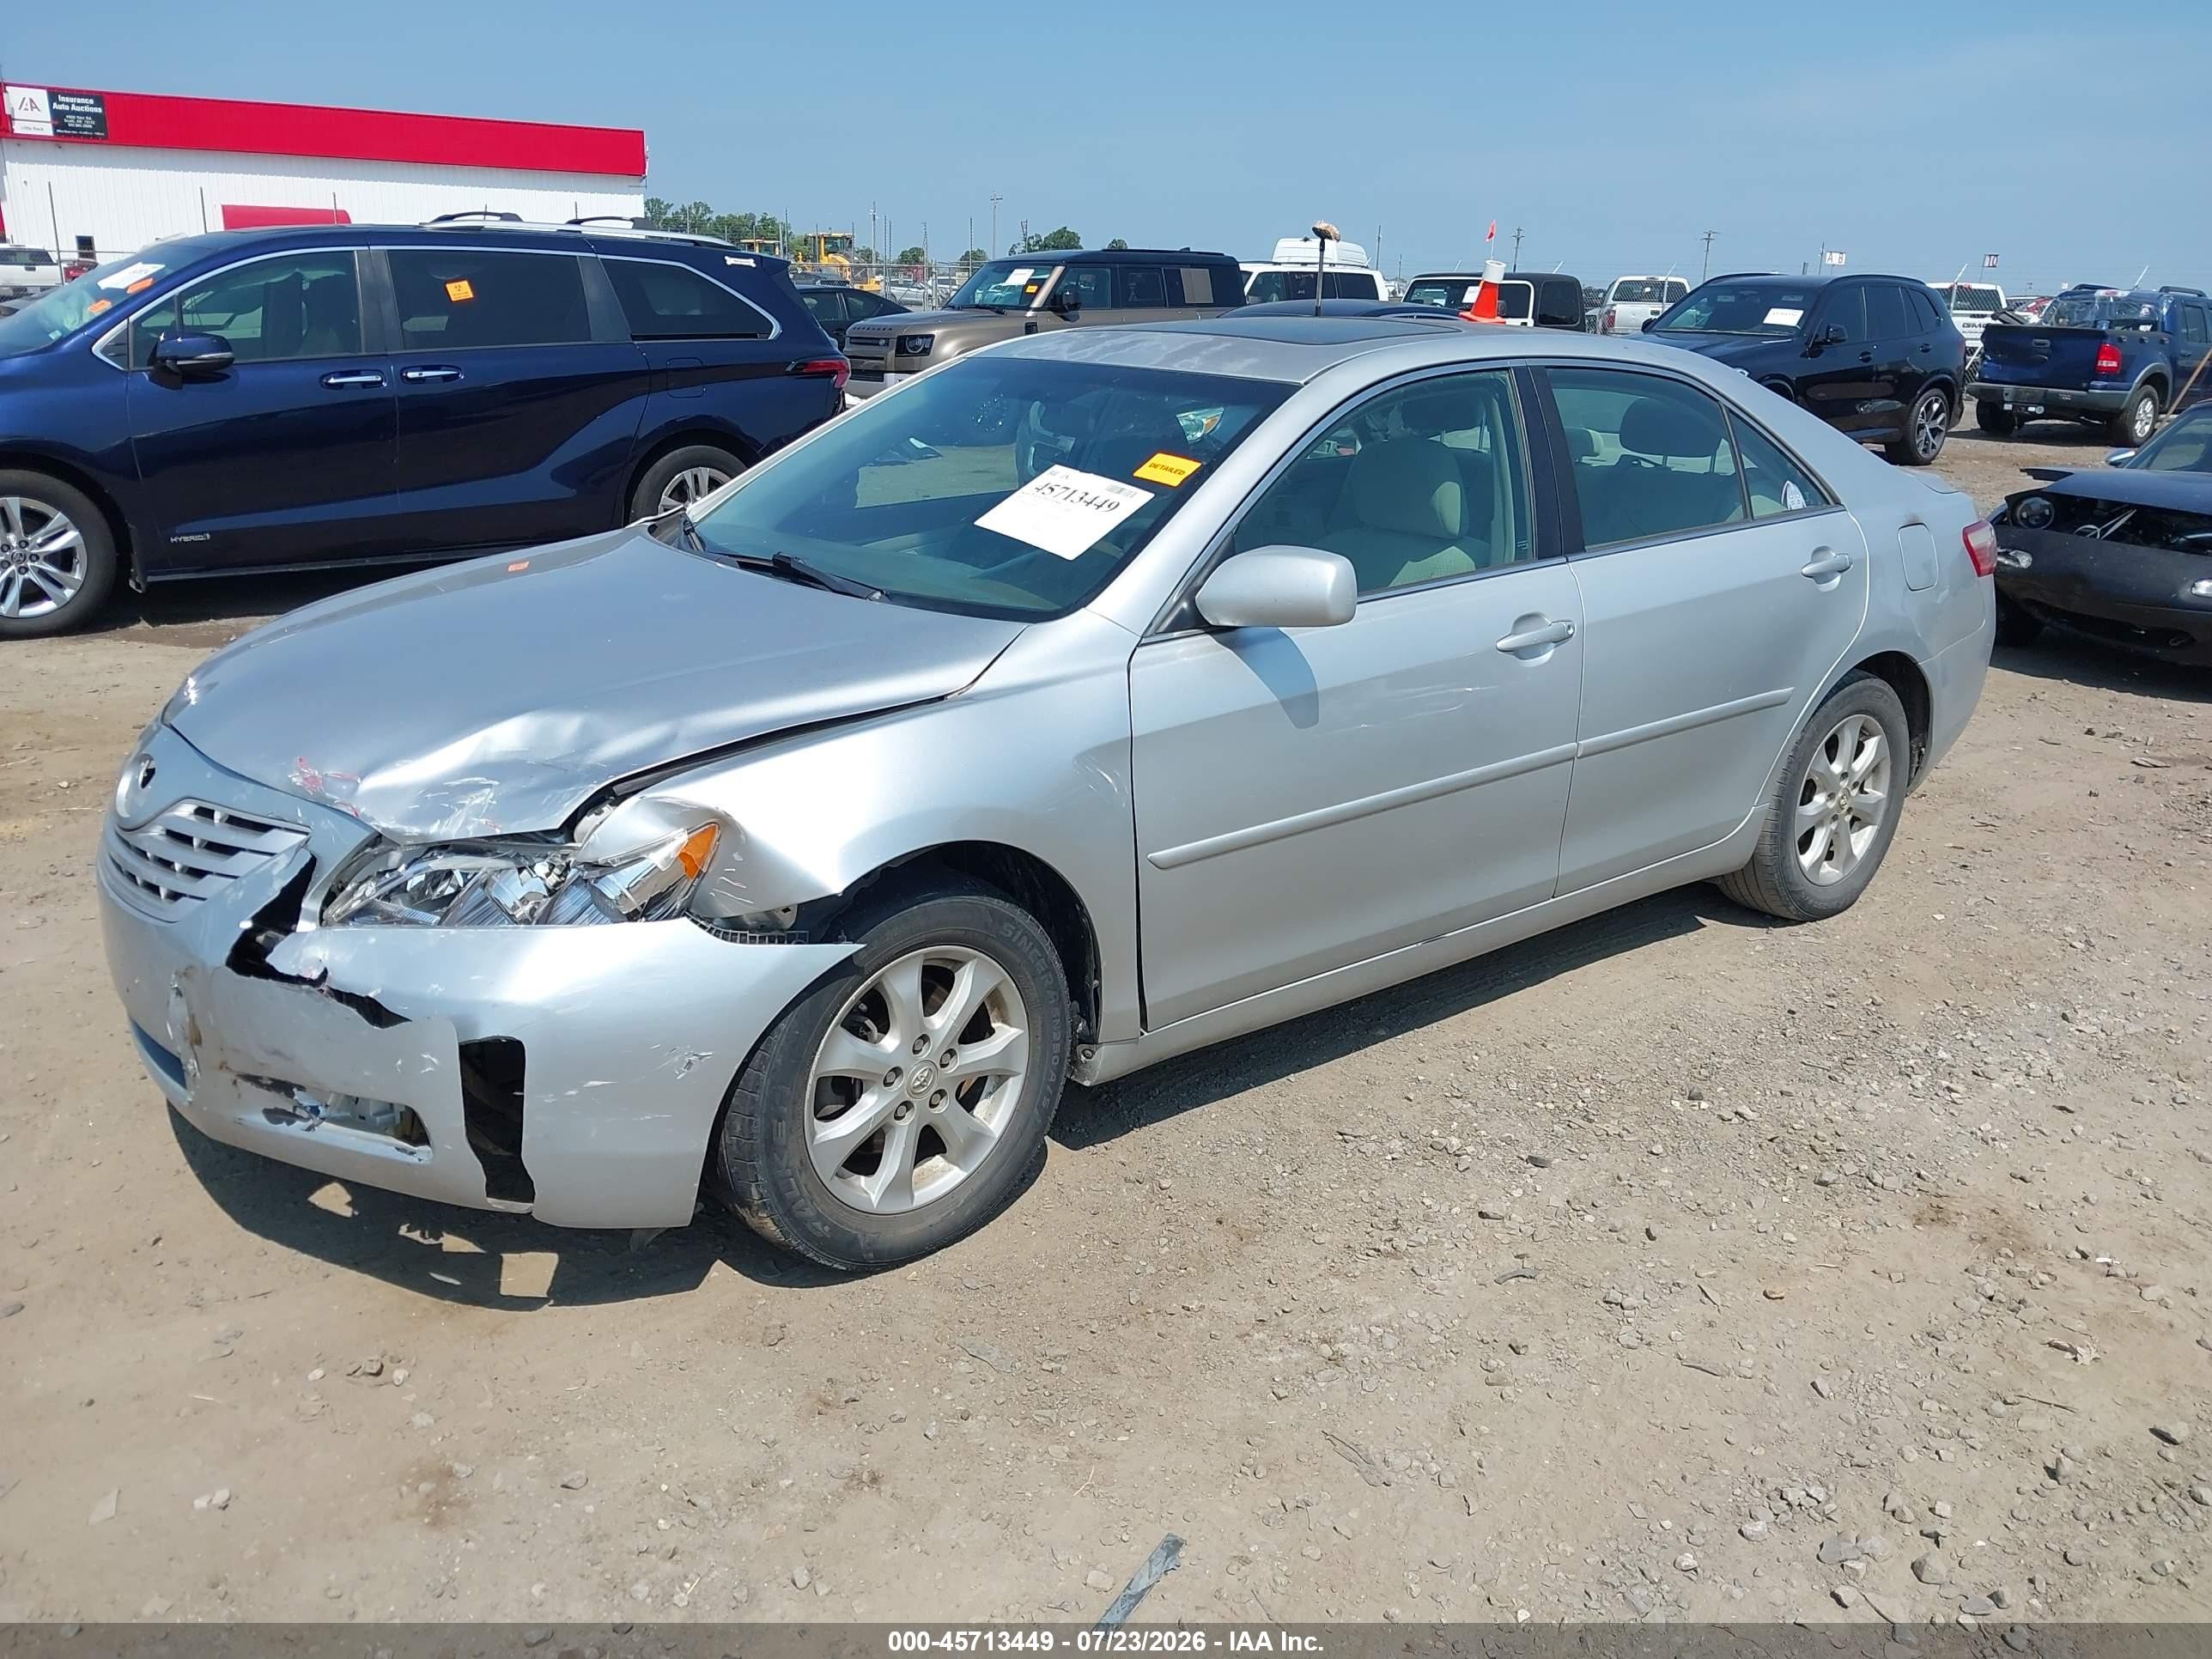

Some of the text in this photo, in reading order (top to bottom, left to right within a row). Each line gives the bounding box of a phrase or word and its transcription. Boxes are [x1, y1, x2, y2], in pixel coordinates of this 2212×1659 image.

[58, 94, 94, 105] Insurance
[52, 102, 103, 113] Auto Auctions
[1148, 462, 1186, 476] DETAILED
[1034, 482, 1121, 513] 45713449
